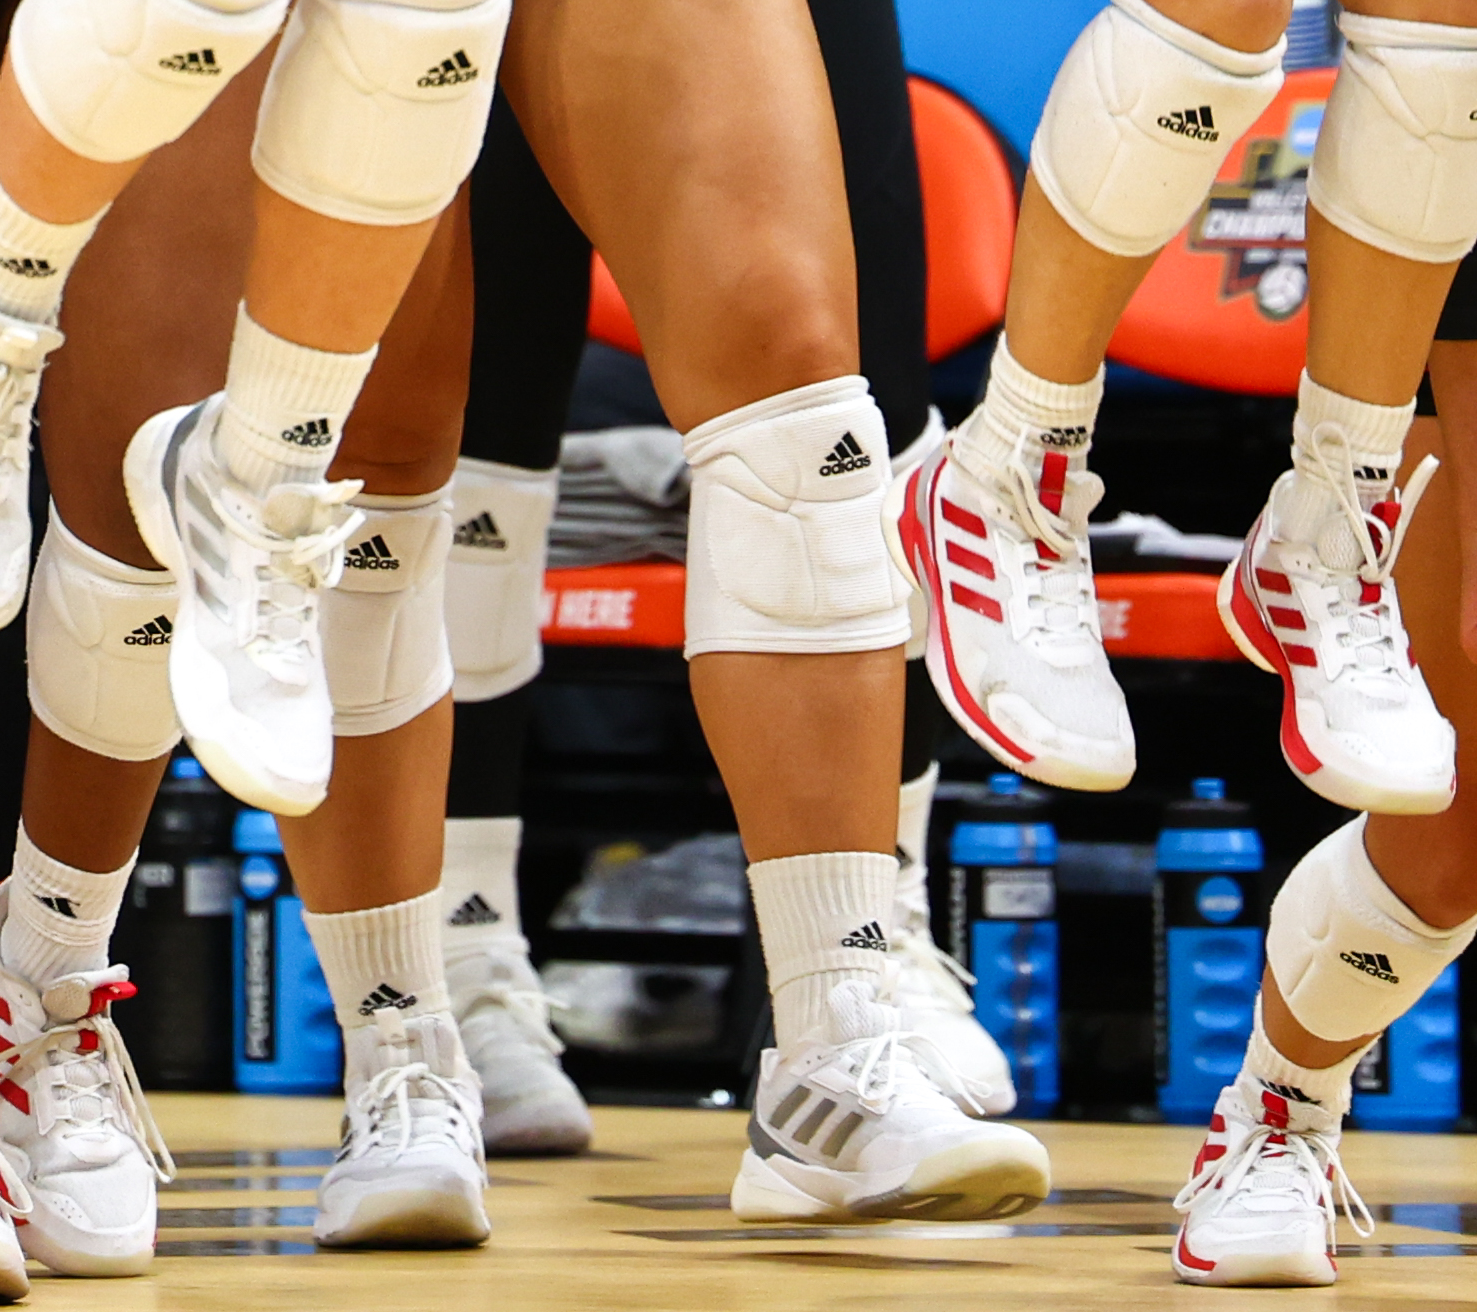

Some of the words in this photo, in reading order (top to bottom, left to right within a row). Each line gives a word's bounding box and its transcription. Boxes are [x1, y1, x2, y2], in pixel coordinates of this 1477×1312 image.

[1157, 115, 1220, 143] adidas
[819, 455, 872, 477] adidas
[1340, 951, 1399, 984] adidas
